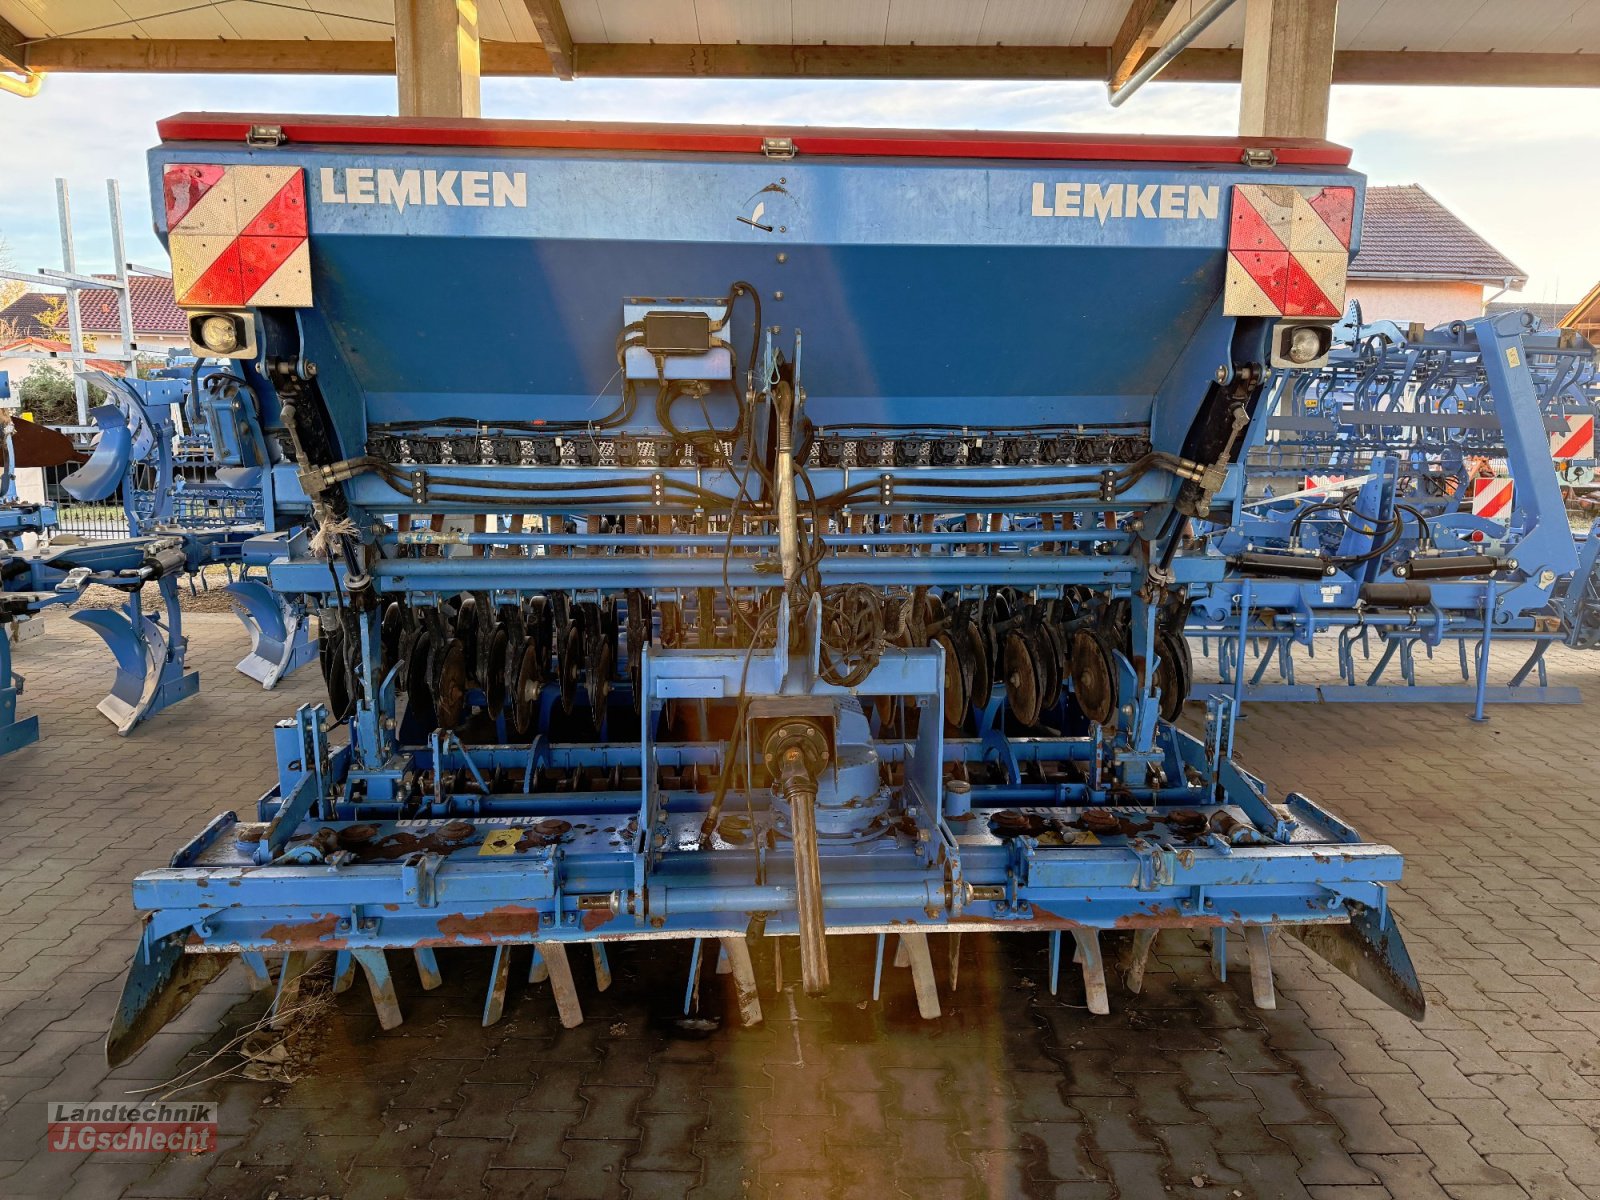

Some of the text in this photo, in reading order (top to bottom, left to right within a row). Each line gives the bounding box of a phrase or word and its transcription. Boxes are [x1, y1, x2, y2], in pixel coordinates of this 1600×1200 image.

[320, 167, 527, 214] LEMKEN
[1031, 182, 1219, 226] LEMKEN
[473, 815, 546, 826] Zirkon
